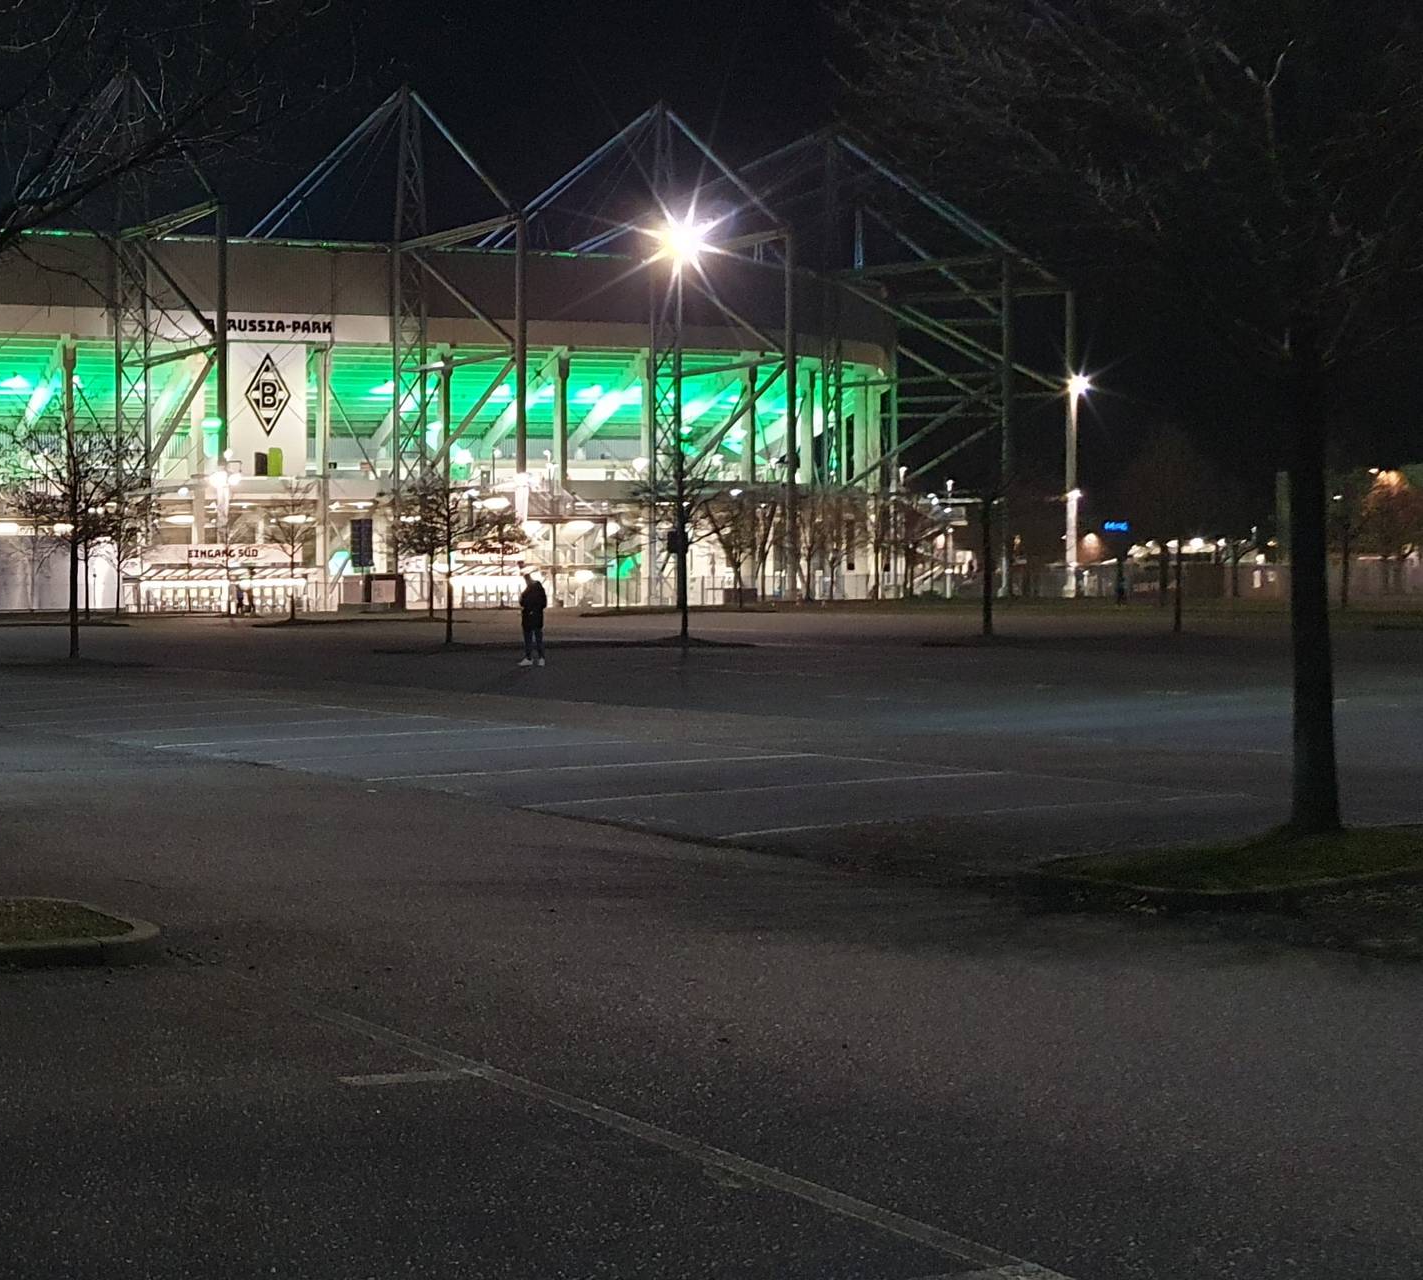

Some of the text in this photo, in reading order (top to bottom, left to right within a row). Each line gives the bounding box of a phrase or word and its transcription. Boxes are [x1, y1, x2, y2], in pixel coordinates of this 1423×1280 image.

[204, 319, 332, 333] RUSSIA-PARK
[261, 381, 278, 409] B
[188, 549, 235, 558] EINGANG
